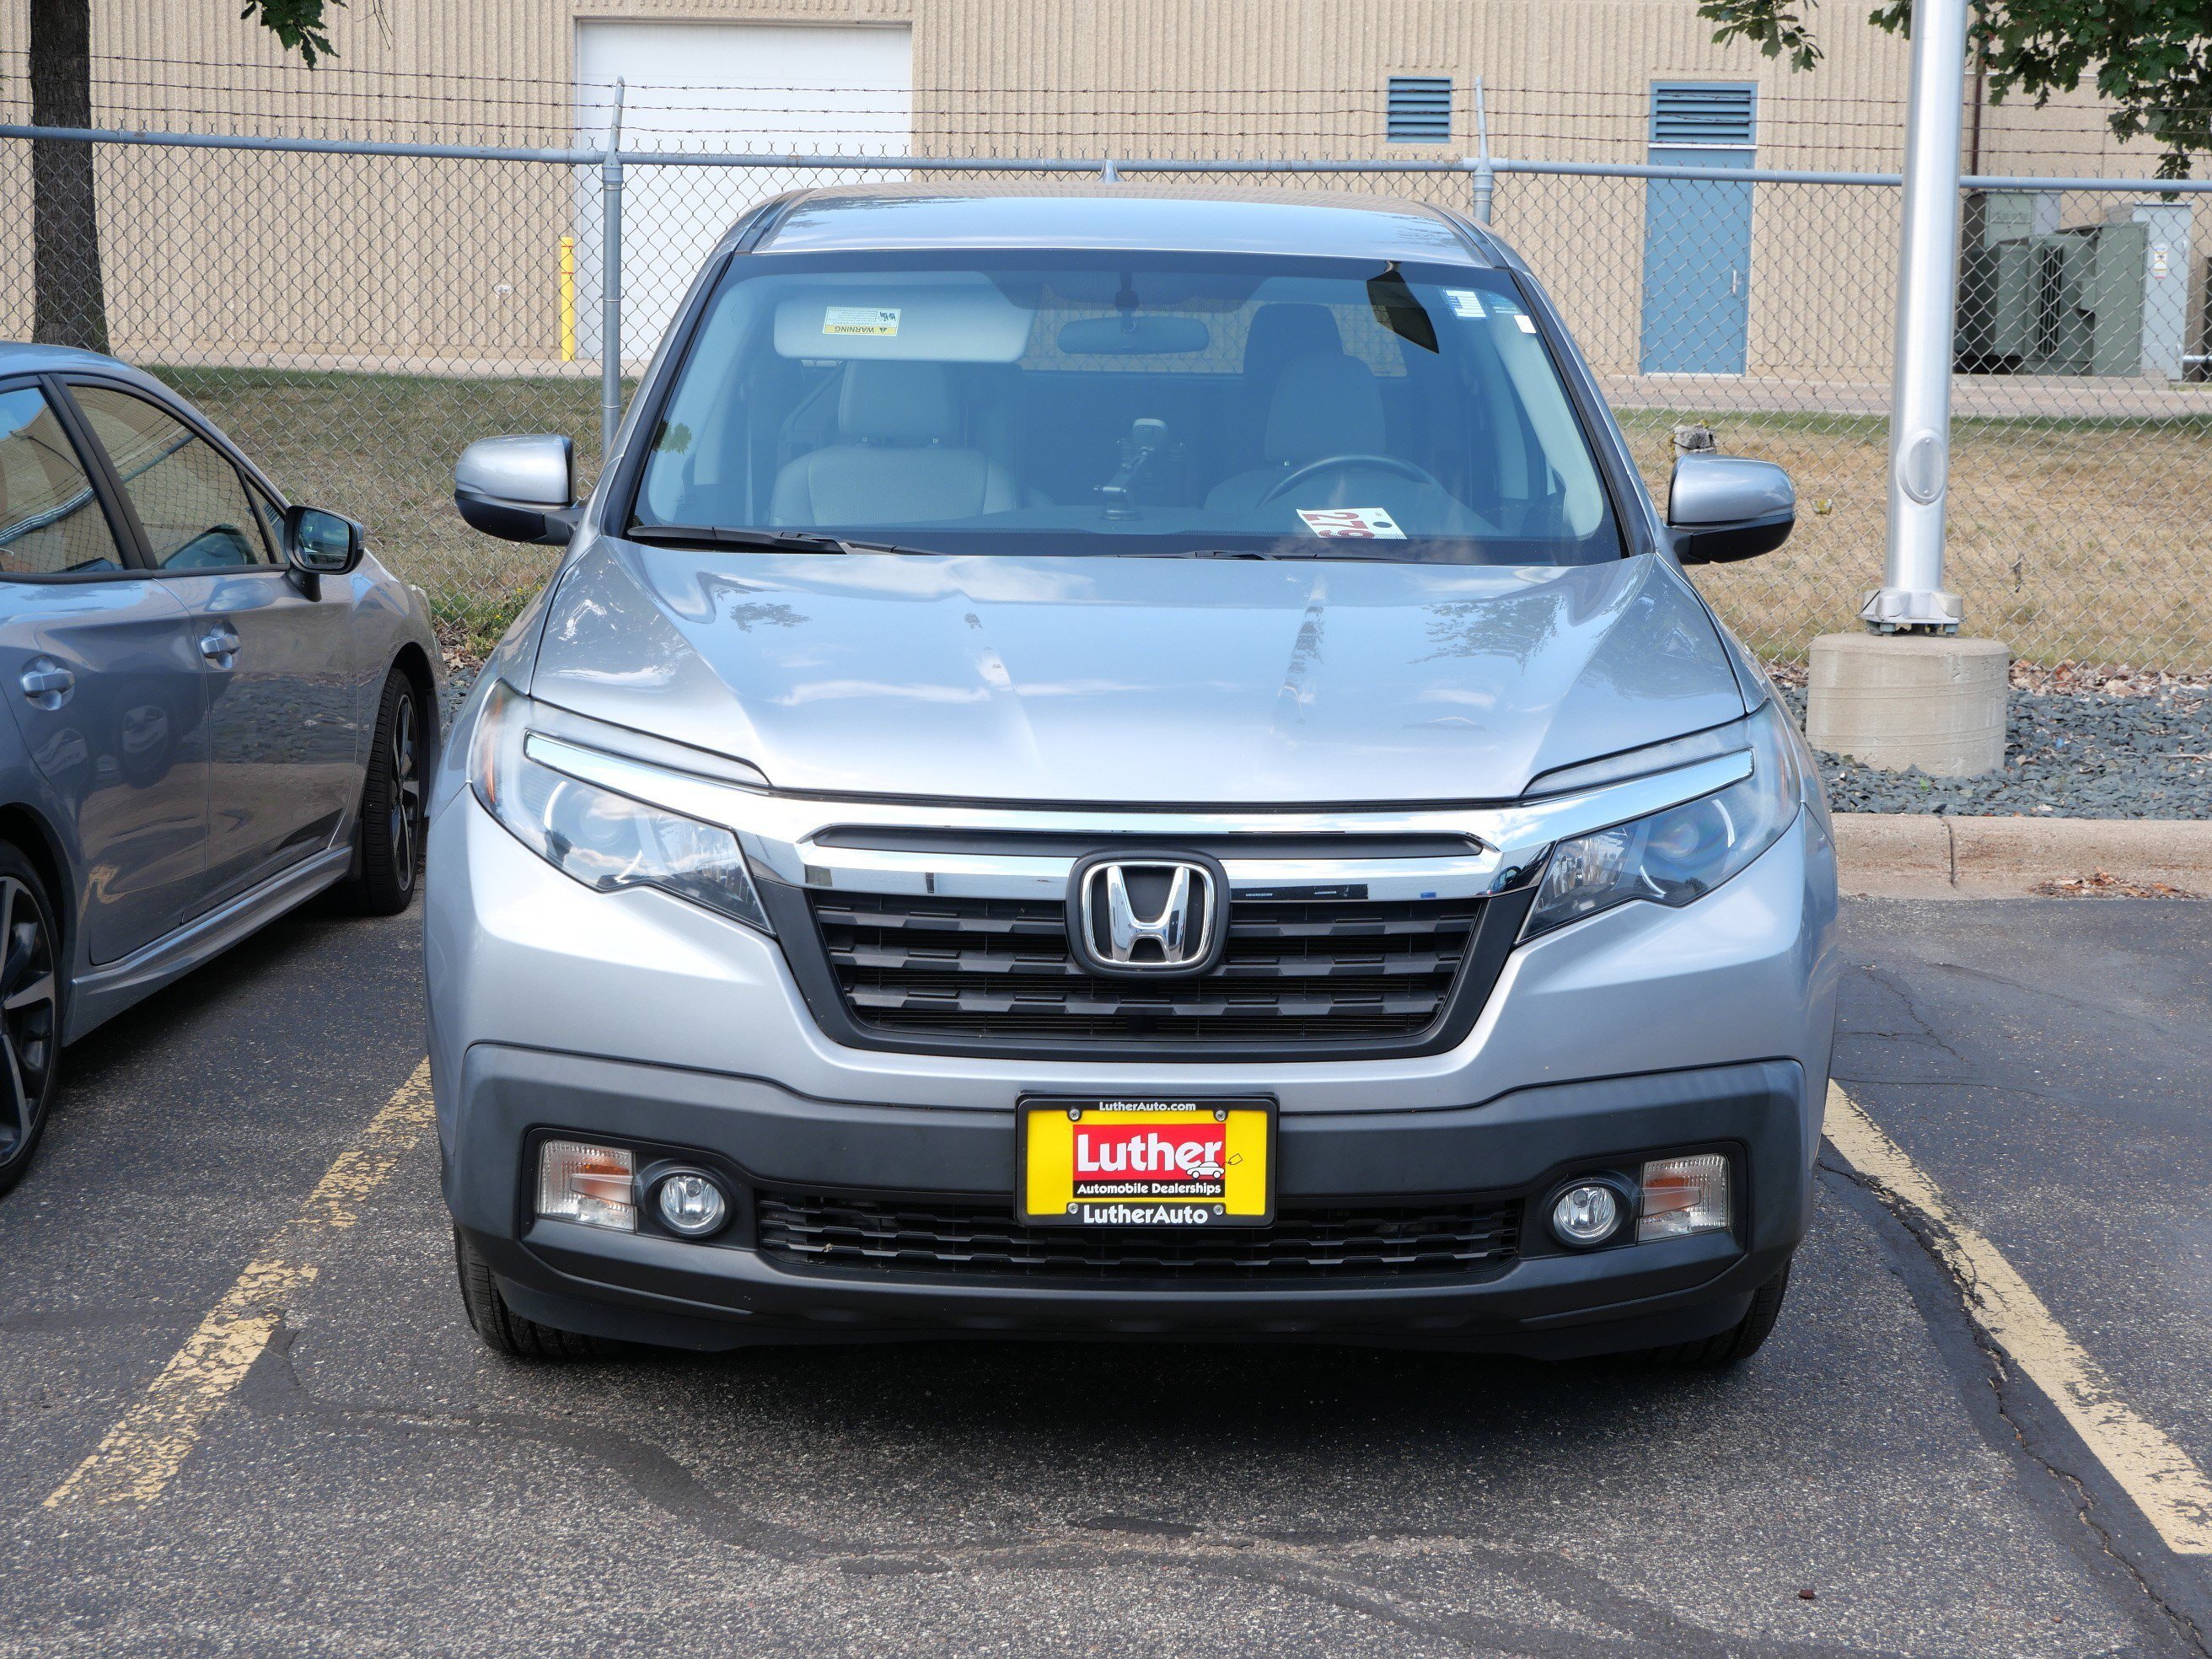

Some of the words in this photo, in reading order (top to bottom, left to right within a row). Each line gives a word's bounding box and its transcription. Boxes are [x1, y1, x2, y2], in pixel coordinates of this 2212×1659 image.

[1302, 512, 1375, 539] 279
[1099, 1101, 1196, 1112] LutherAuto.com
[1077, 1132, 1222, 1172] Luther
[1076, 1183, 1149, 1195] Automobile
[1152, 1183, 1221, 1195] Dealerships
[1083, 1205, 1208, 1224] LutherAuto
